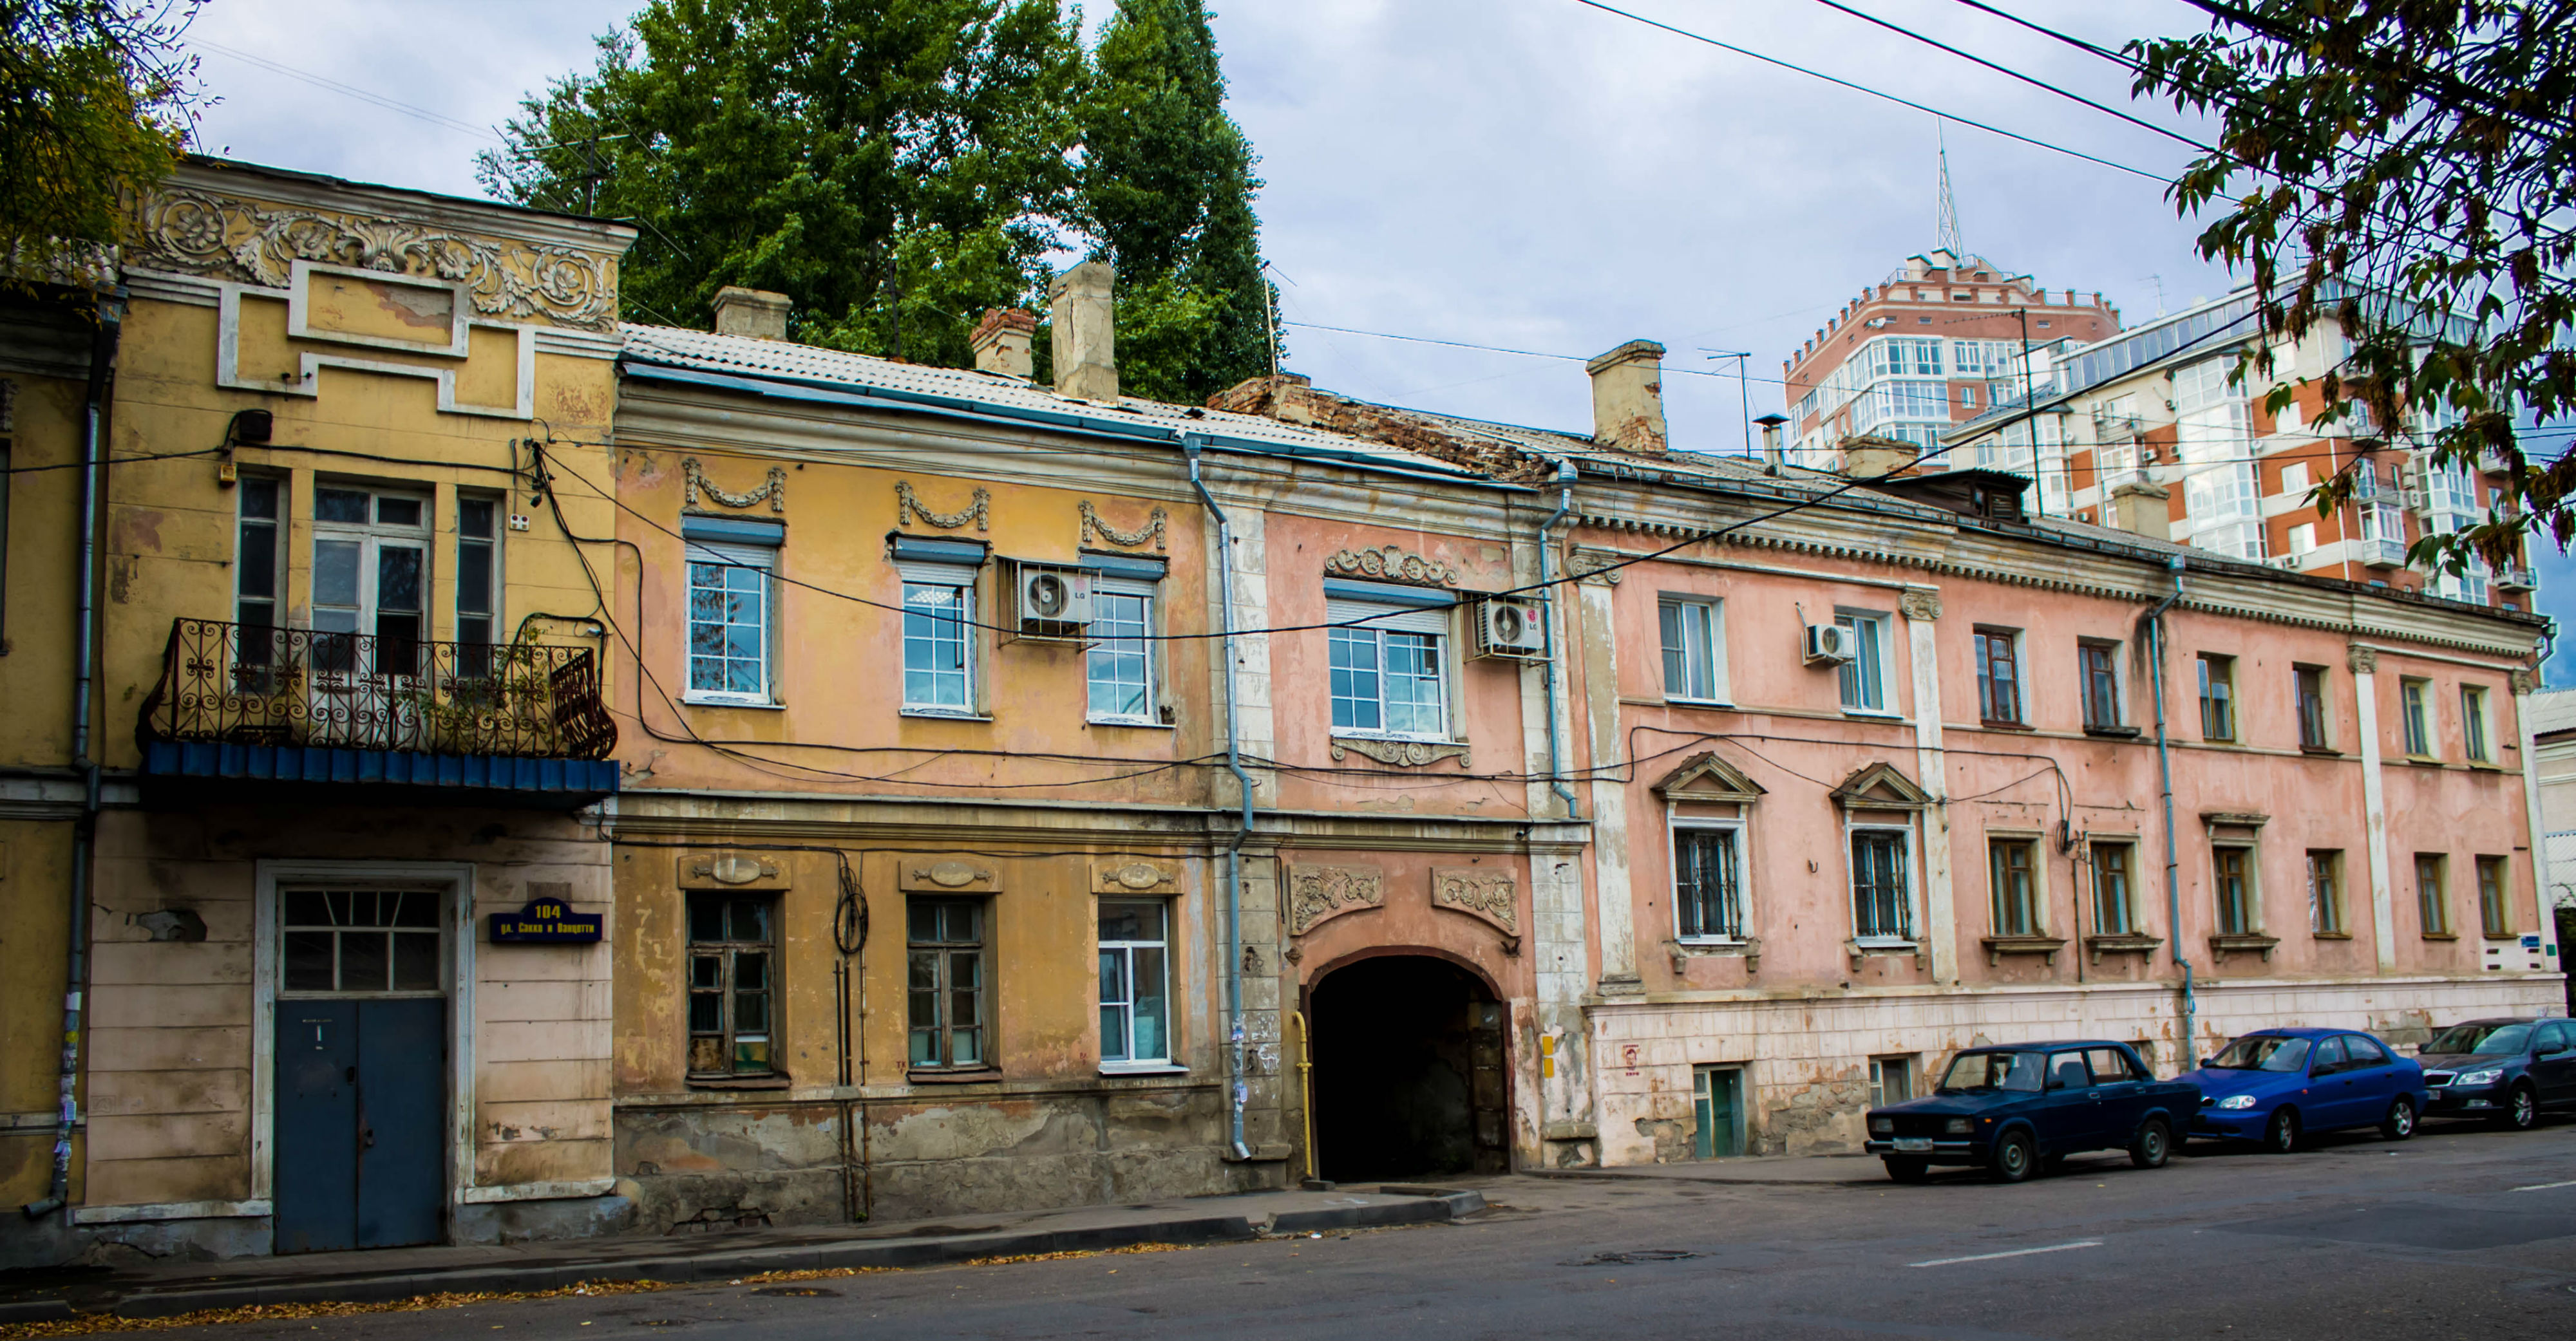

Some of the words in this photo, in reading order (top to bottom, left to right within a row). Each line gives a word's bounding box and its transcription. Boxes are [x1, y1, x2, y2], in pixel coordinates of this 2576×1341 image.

[535, 905, 560, 919] 104
[501, 923, 513, 935] ул.
[518, 923, 543, 933] Сакко
[547, 924, 553, 933] и
